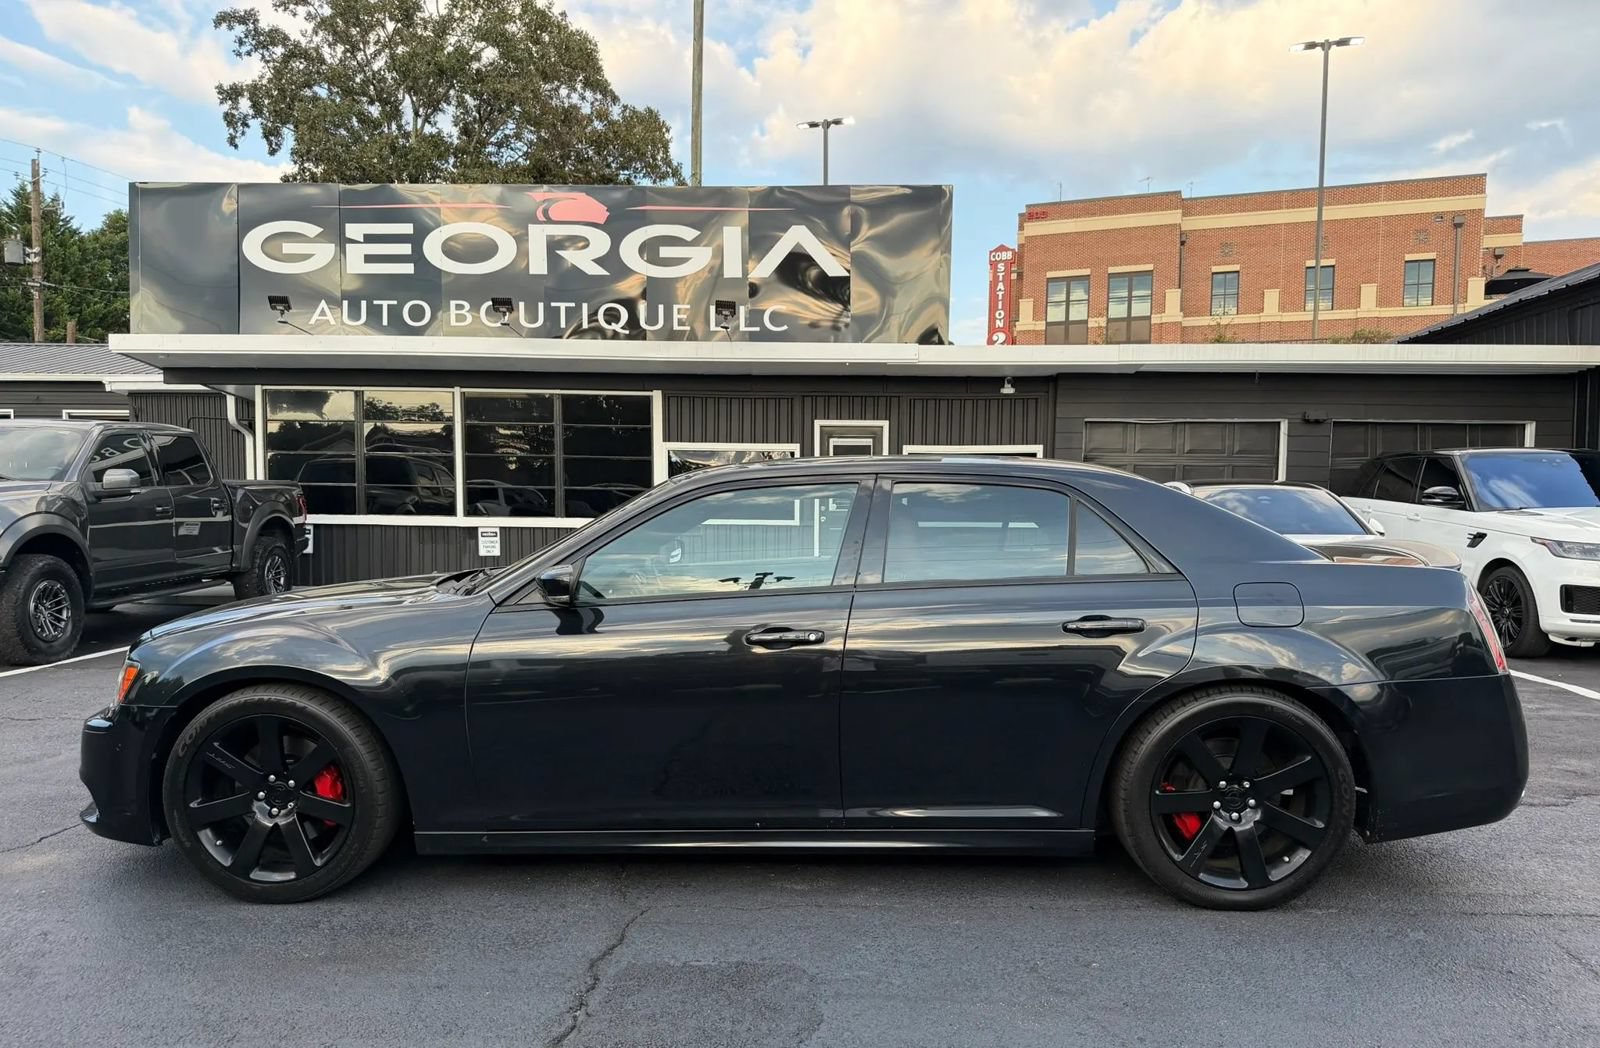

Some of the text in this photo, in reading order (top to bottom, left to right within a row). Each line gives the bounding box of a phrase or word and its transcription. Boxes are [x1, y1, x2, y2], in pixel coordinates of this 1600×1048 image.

[242, 220, 849, 278] GEORGIA
[990, 251, 1012, 261] COBB
[995, 263, 1005, 328] STATION
[308, 299, 789, 334] AUTO BOUTIQUE LLC
[992, 332, 1006, 345] 2
